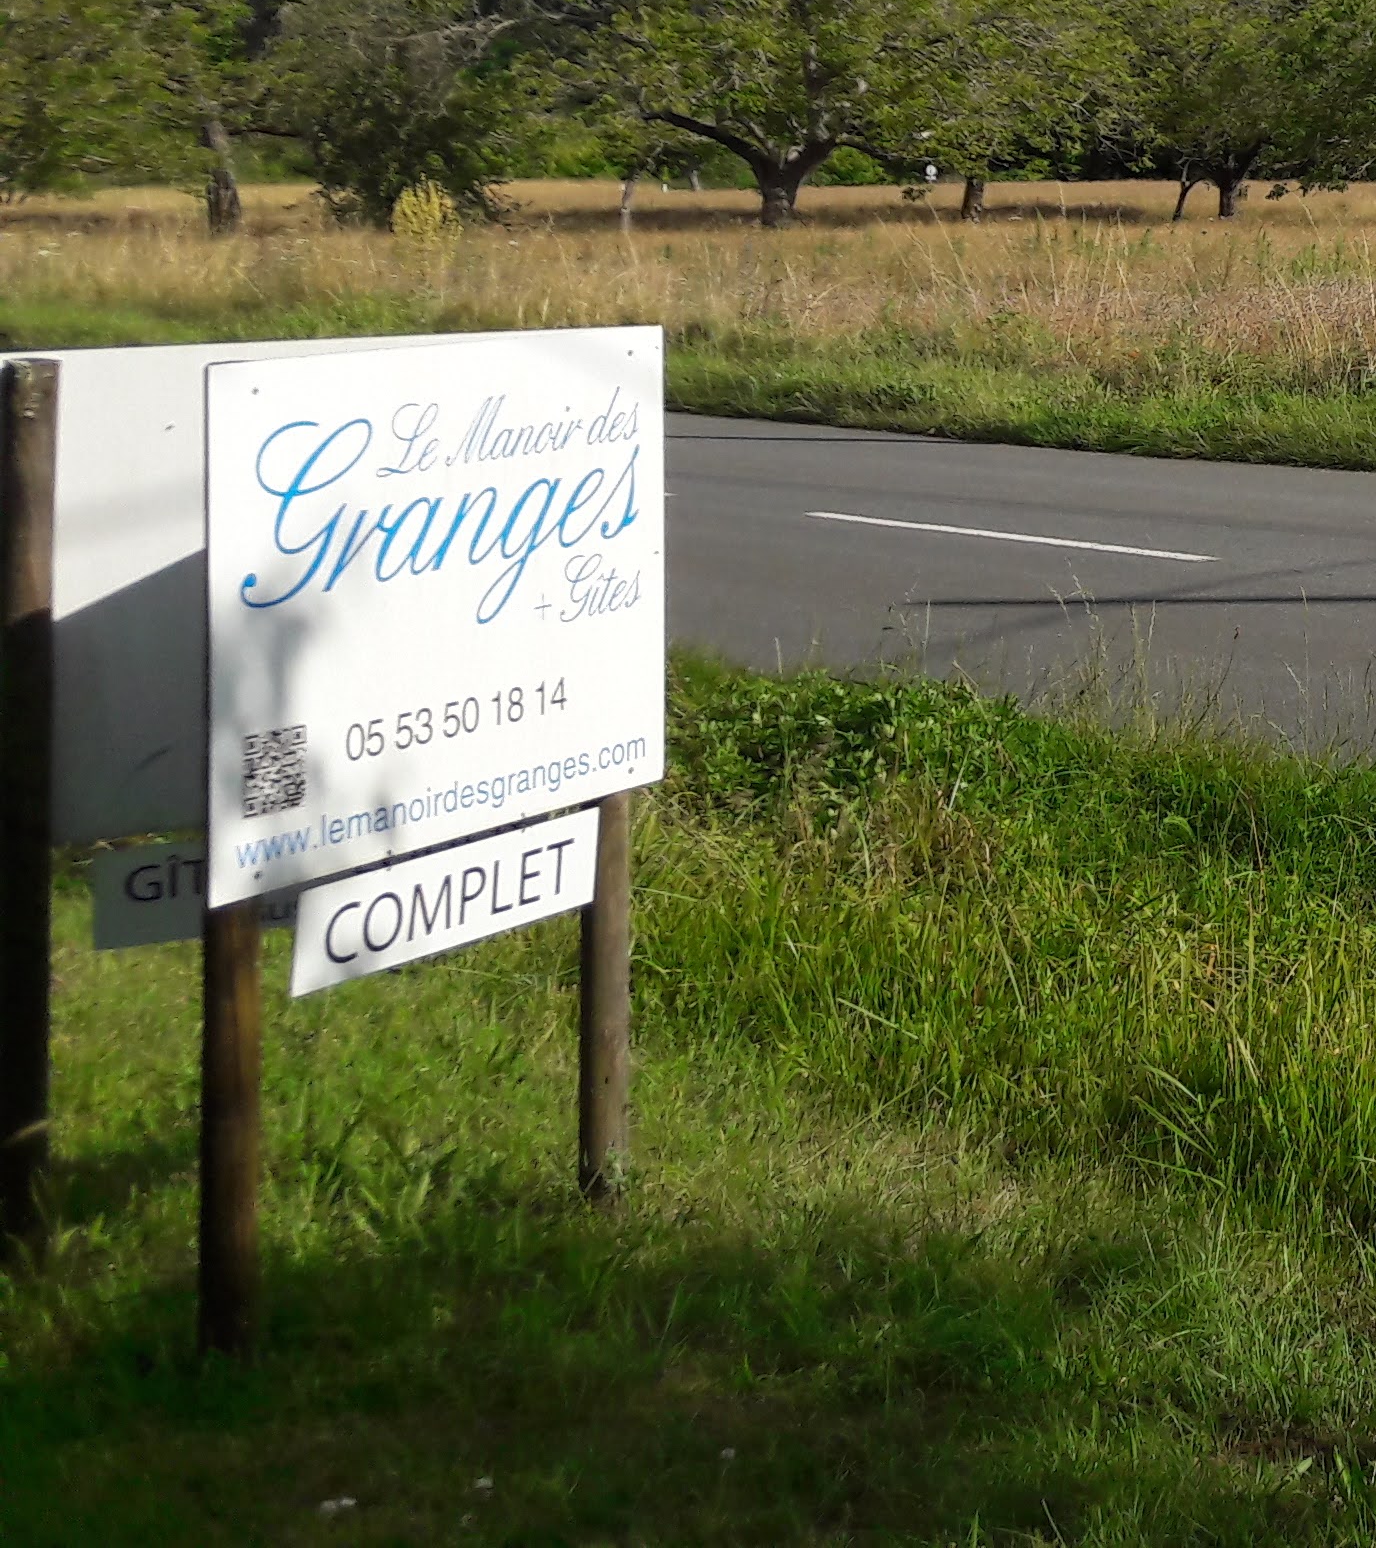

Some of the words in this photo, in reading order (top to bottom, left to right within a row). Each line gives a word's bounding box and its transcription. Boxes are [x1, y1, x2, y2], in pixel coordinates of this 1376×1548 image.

[376, 403, 440, 477] Le
[444, 394, 583, 467] Manoir
[587, 386, 639, 445] des
[241, 419, 639, 624] Granges
[346, 718, 385, 761] 05
[395, 708, 434, 750] 53
[442, 696, 480, 739] 50
[491, 686, 525, 726] 18
[535, 676, 567, 716] 14
[236, 736, 647, 868] www.lemanoirdesgranges.com
[324, 838, 576, 964] COMPLET
